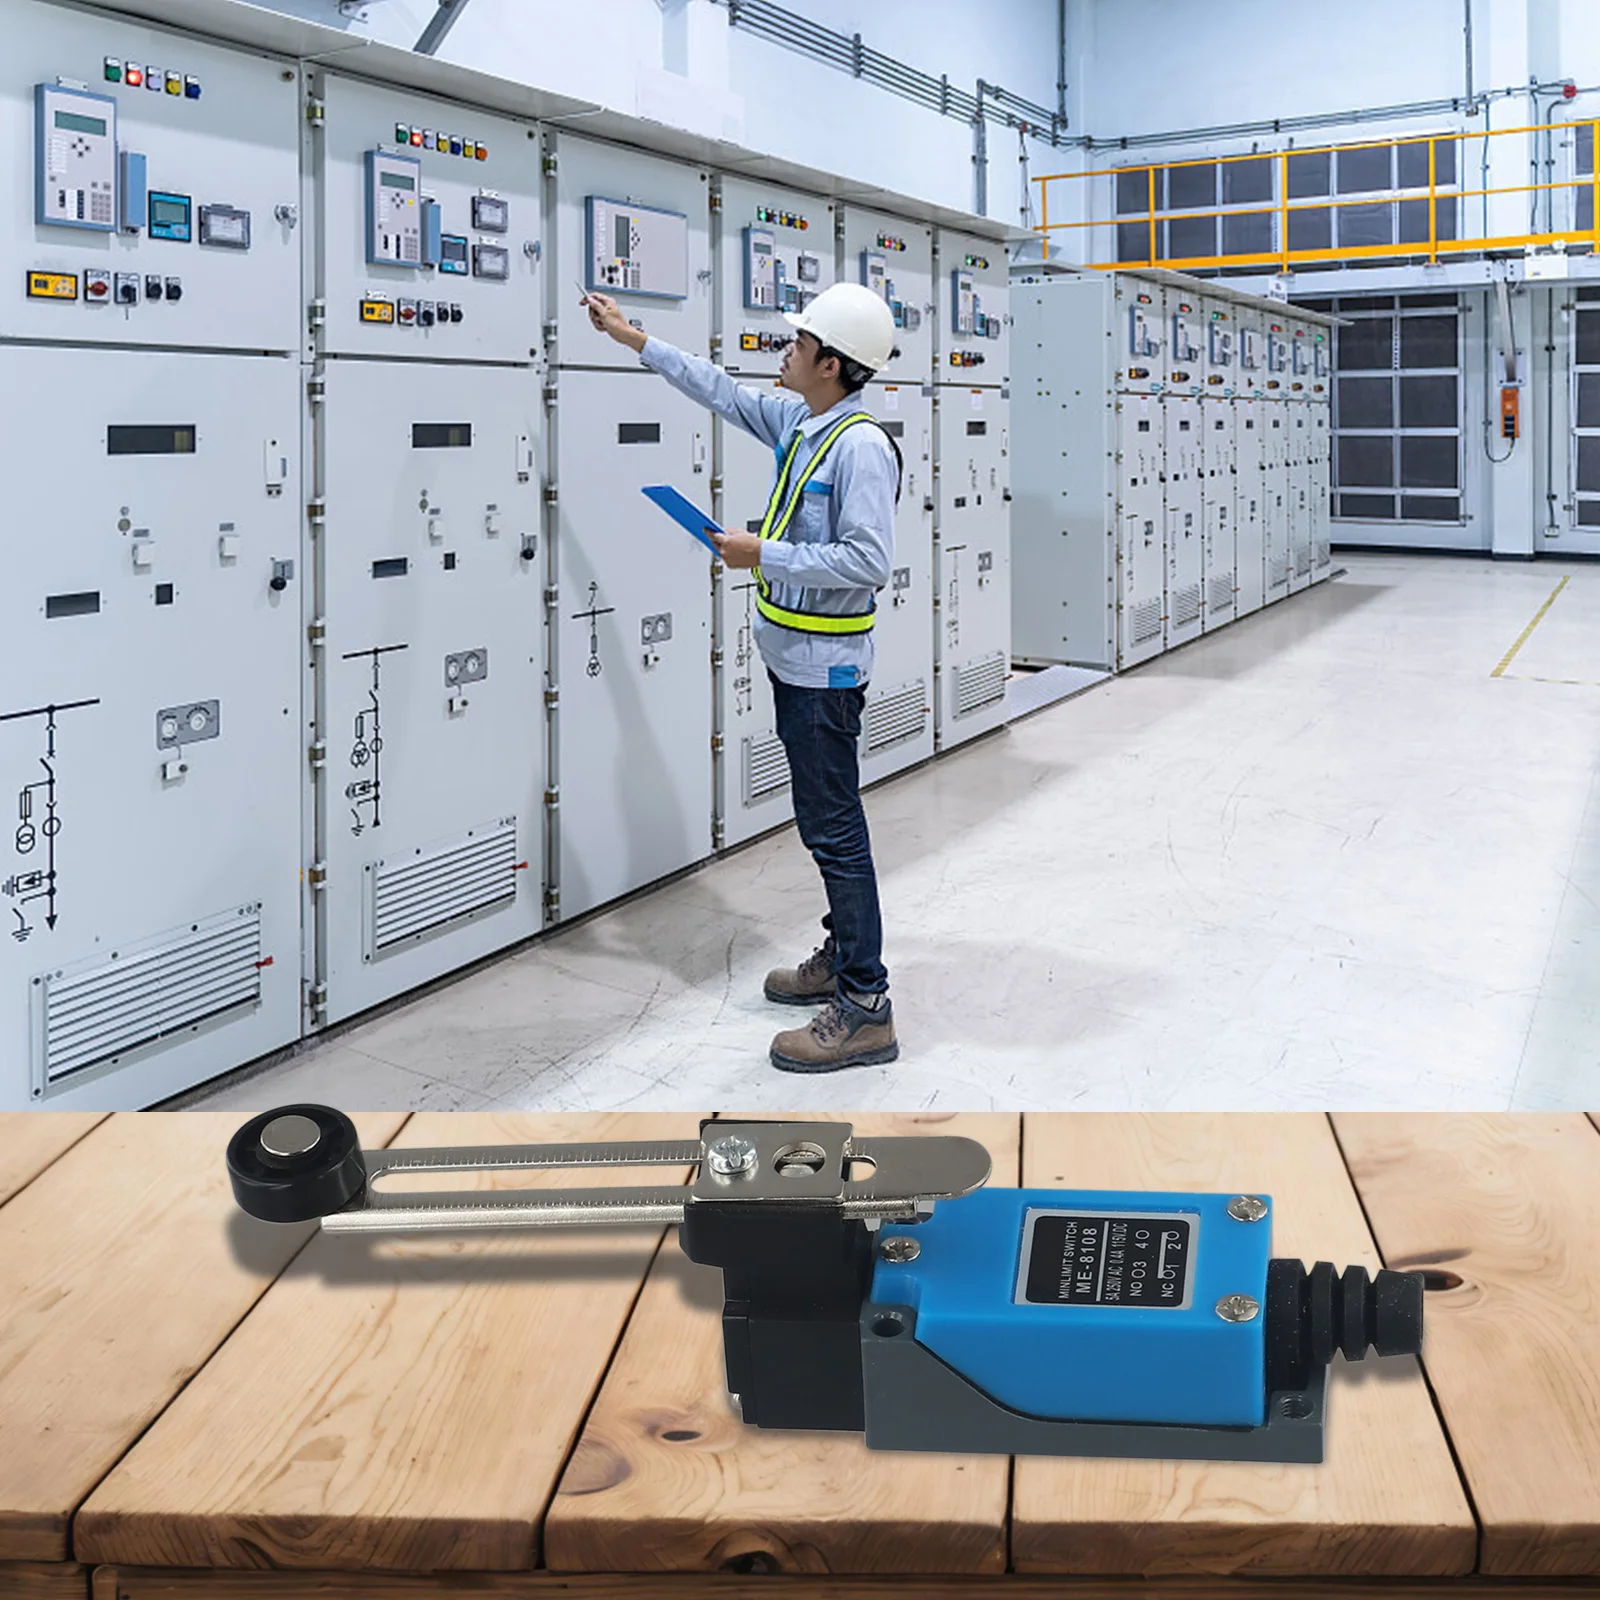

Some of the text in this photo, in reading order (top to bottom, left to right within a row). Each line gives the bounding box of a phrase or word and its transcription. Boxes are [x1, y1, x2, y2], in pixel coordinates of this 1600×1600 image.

[1058, 1221, 1078, 1299] MINLIMIT SWITCH
[1075, 1228, 1098, 1293] ME-8108
[1129, 1281, 1143, 1297] NO
[1161, 1282, 1174, 1298] NC
